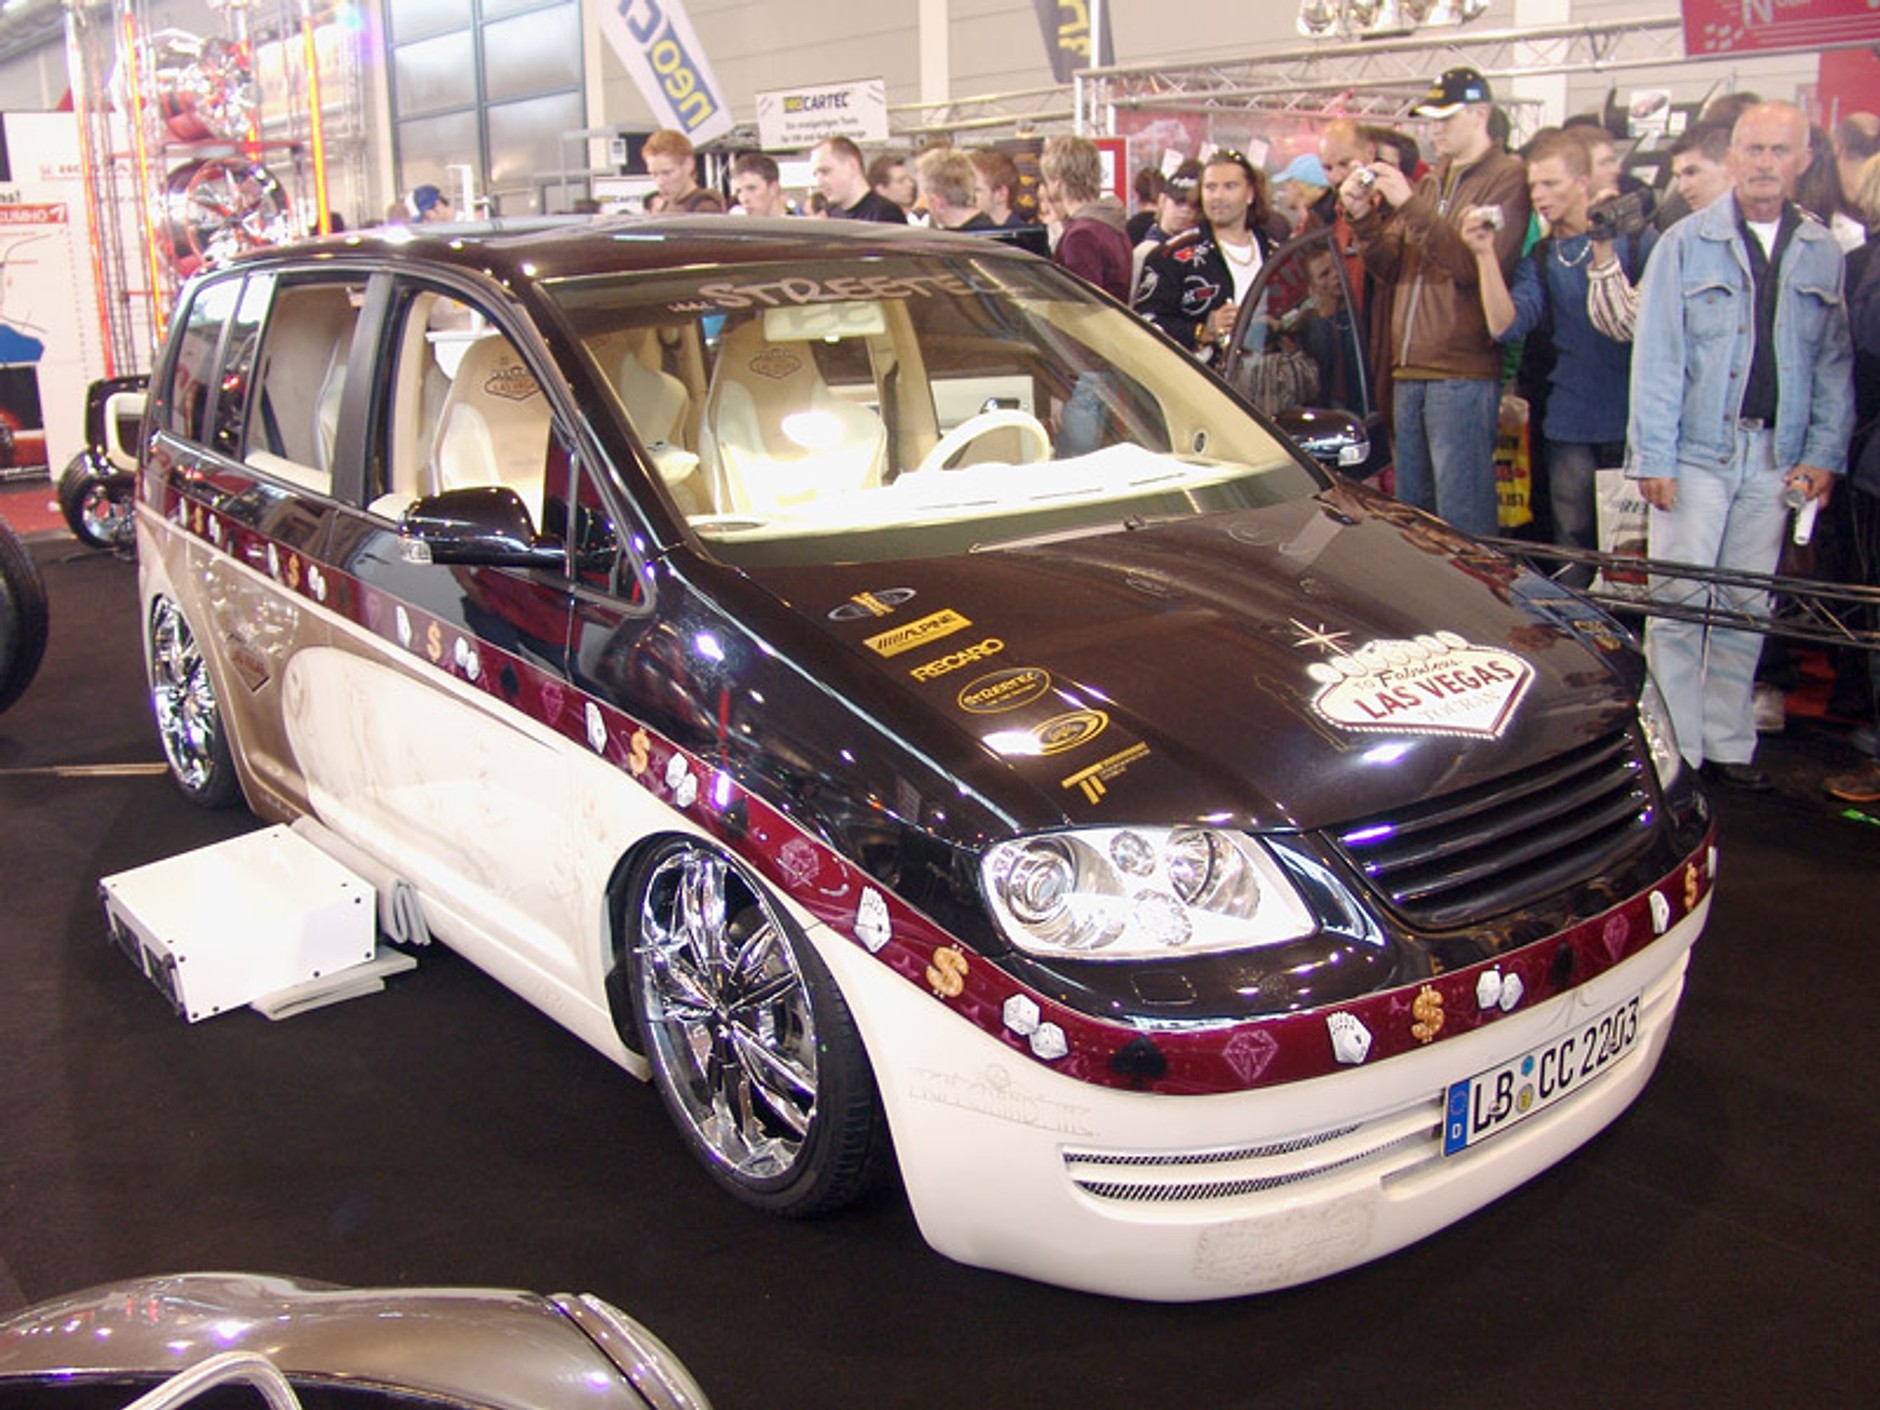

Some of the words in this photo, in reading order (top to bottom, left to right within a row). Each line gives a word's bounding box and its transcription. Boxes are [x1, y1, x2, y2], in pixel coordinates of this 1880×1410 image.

[909, 638, 1005, 683] RECARO
[1353, 685, 1422, 720] LAS
[1414, 660, 1516, 699] VEGAS
[1451, 1123, 1462, 1140] D
[1473, 1070, 1515, 1134] LB
[1538, 1037, 1576, 1100] CC
[1579, 995, 1640, 1078] 2203
